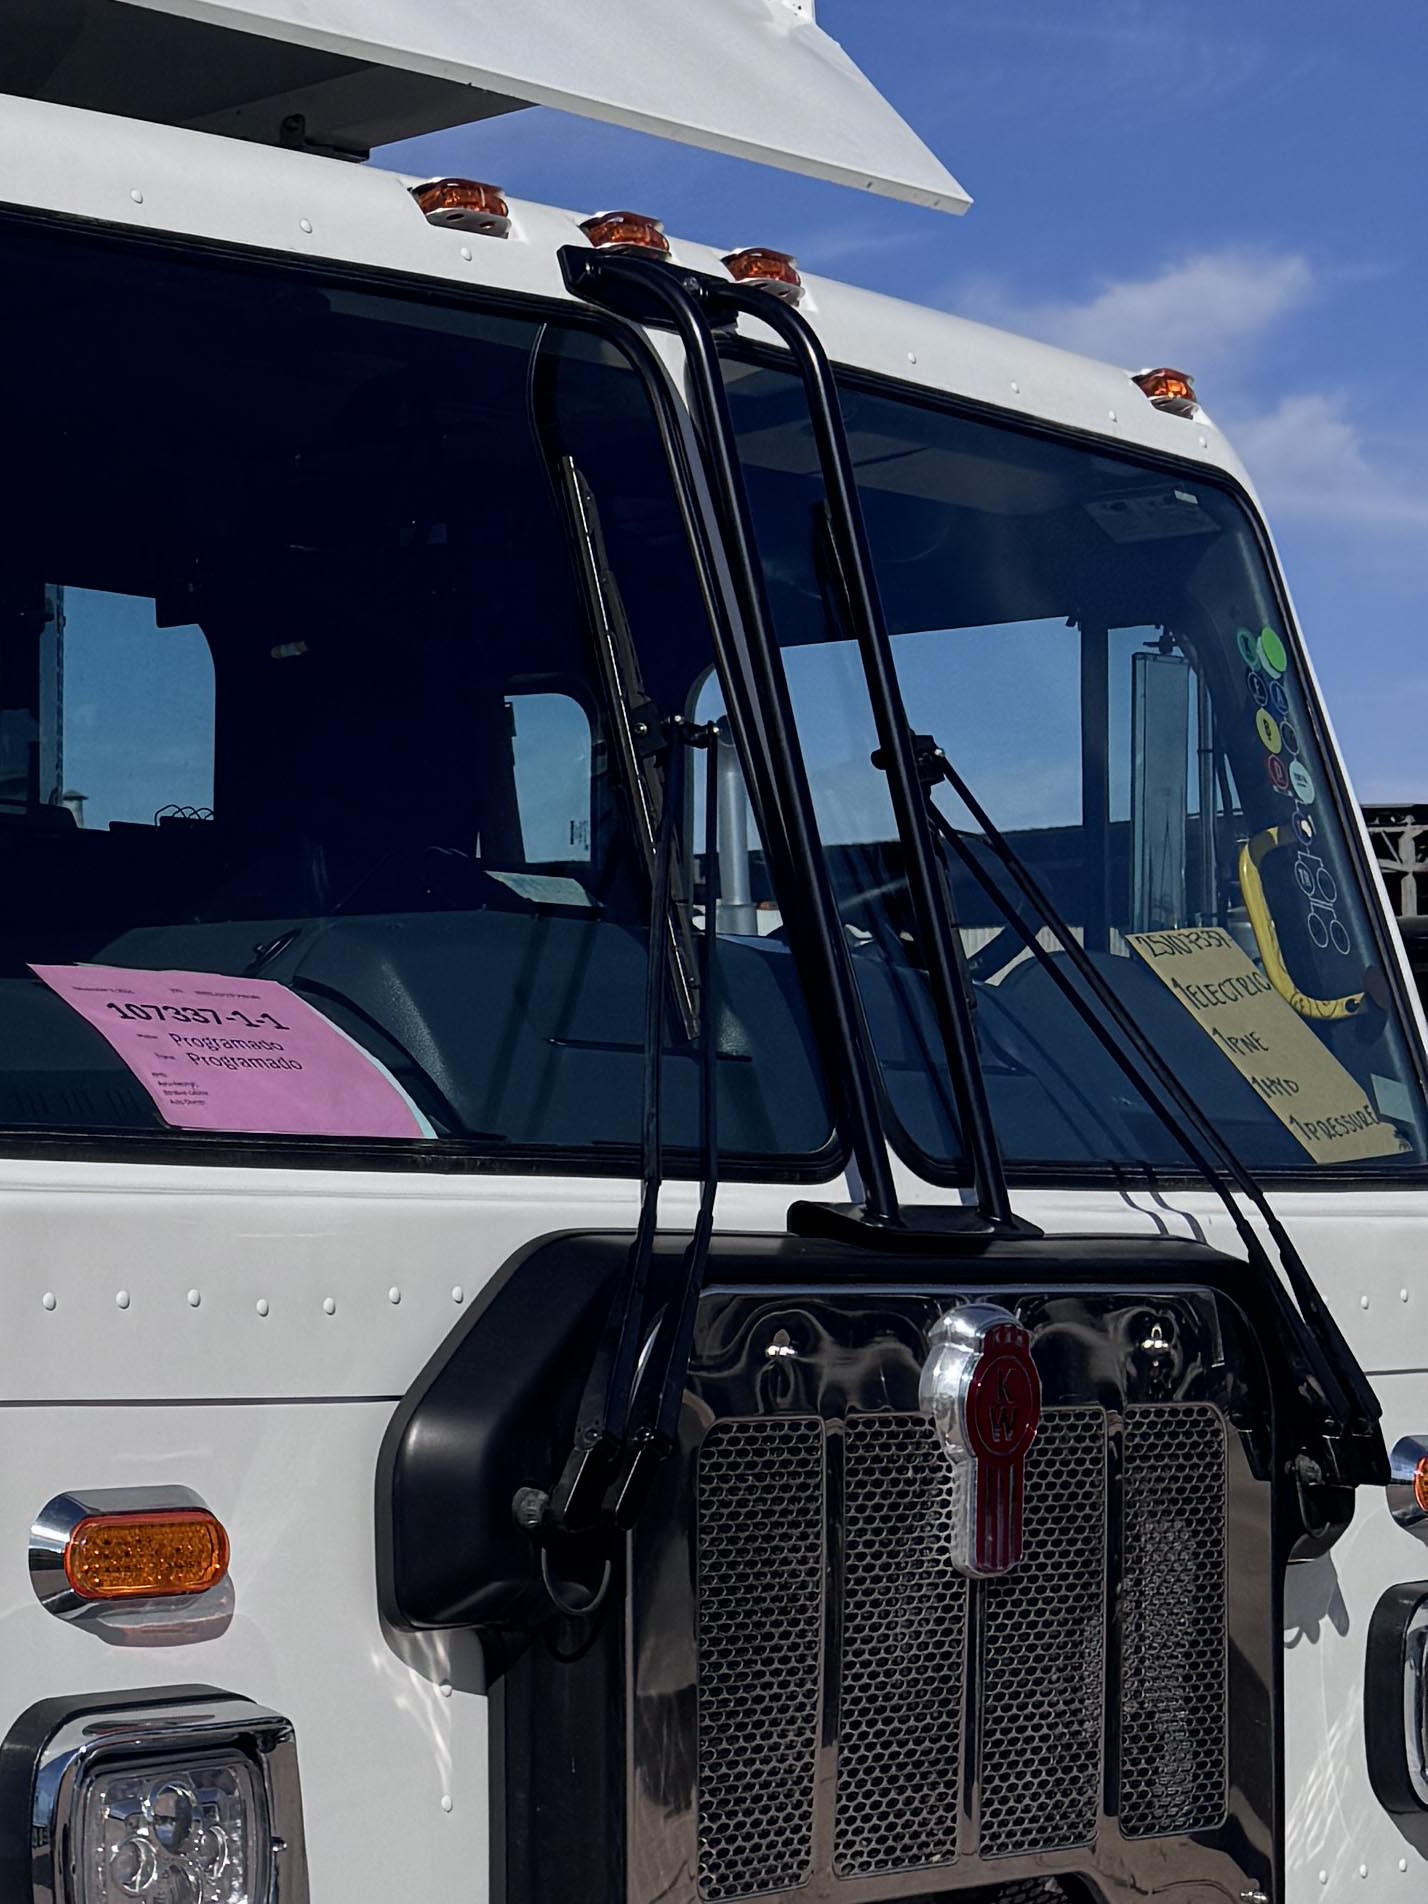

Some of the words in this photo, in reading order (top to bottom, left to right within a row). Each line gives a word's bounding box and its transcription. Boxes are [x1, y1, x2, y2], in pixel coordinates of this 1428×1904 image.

[107, 1002, 290, 1030] 107337-1-1
[168, 1032, 284, 1052] Programado
[186, 1052, 303, 1071] Programado
